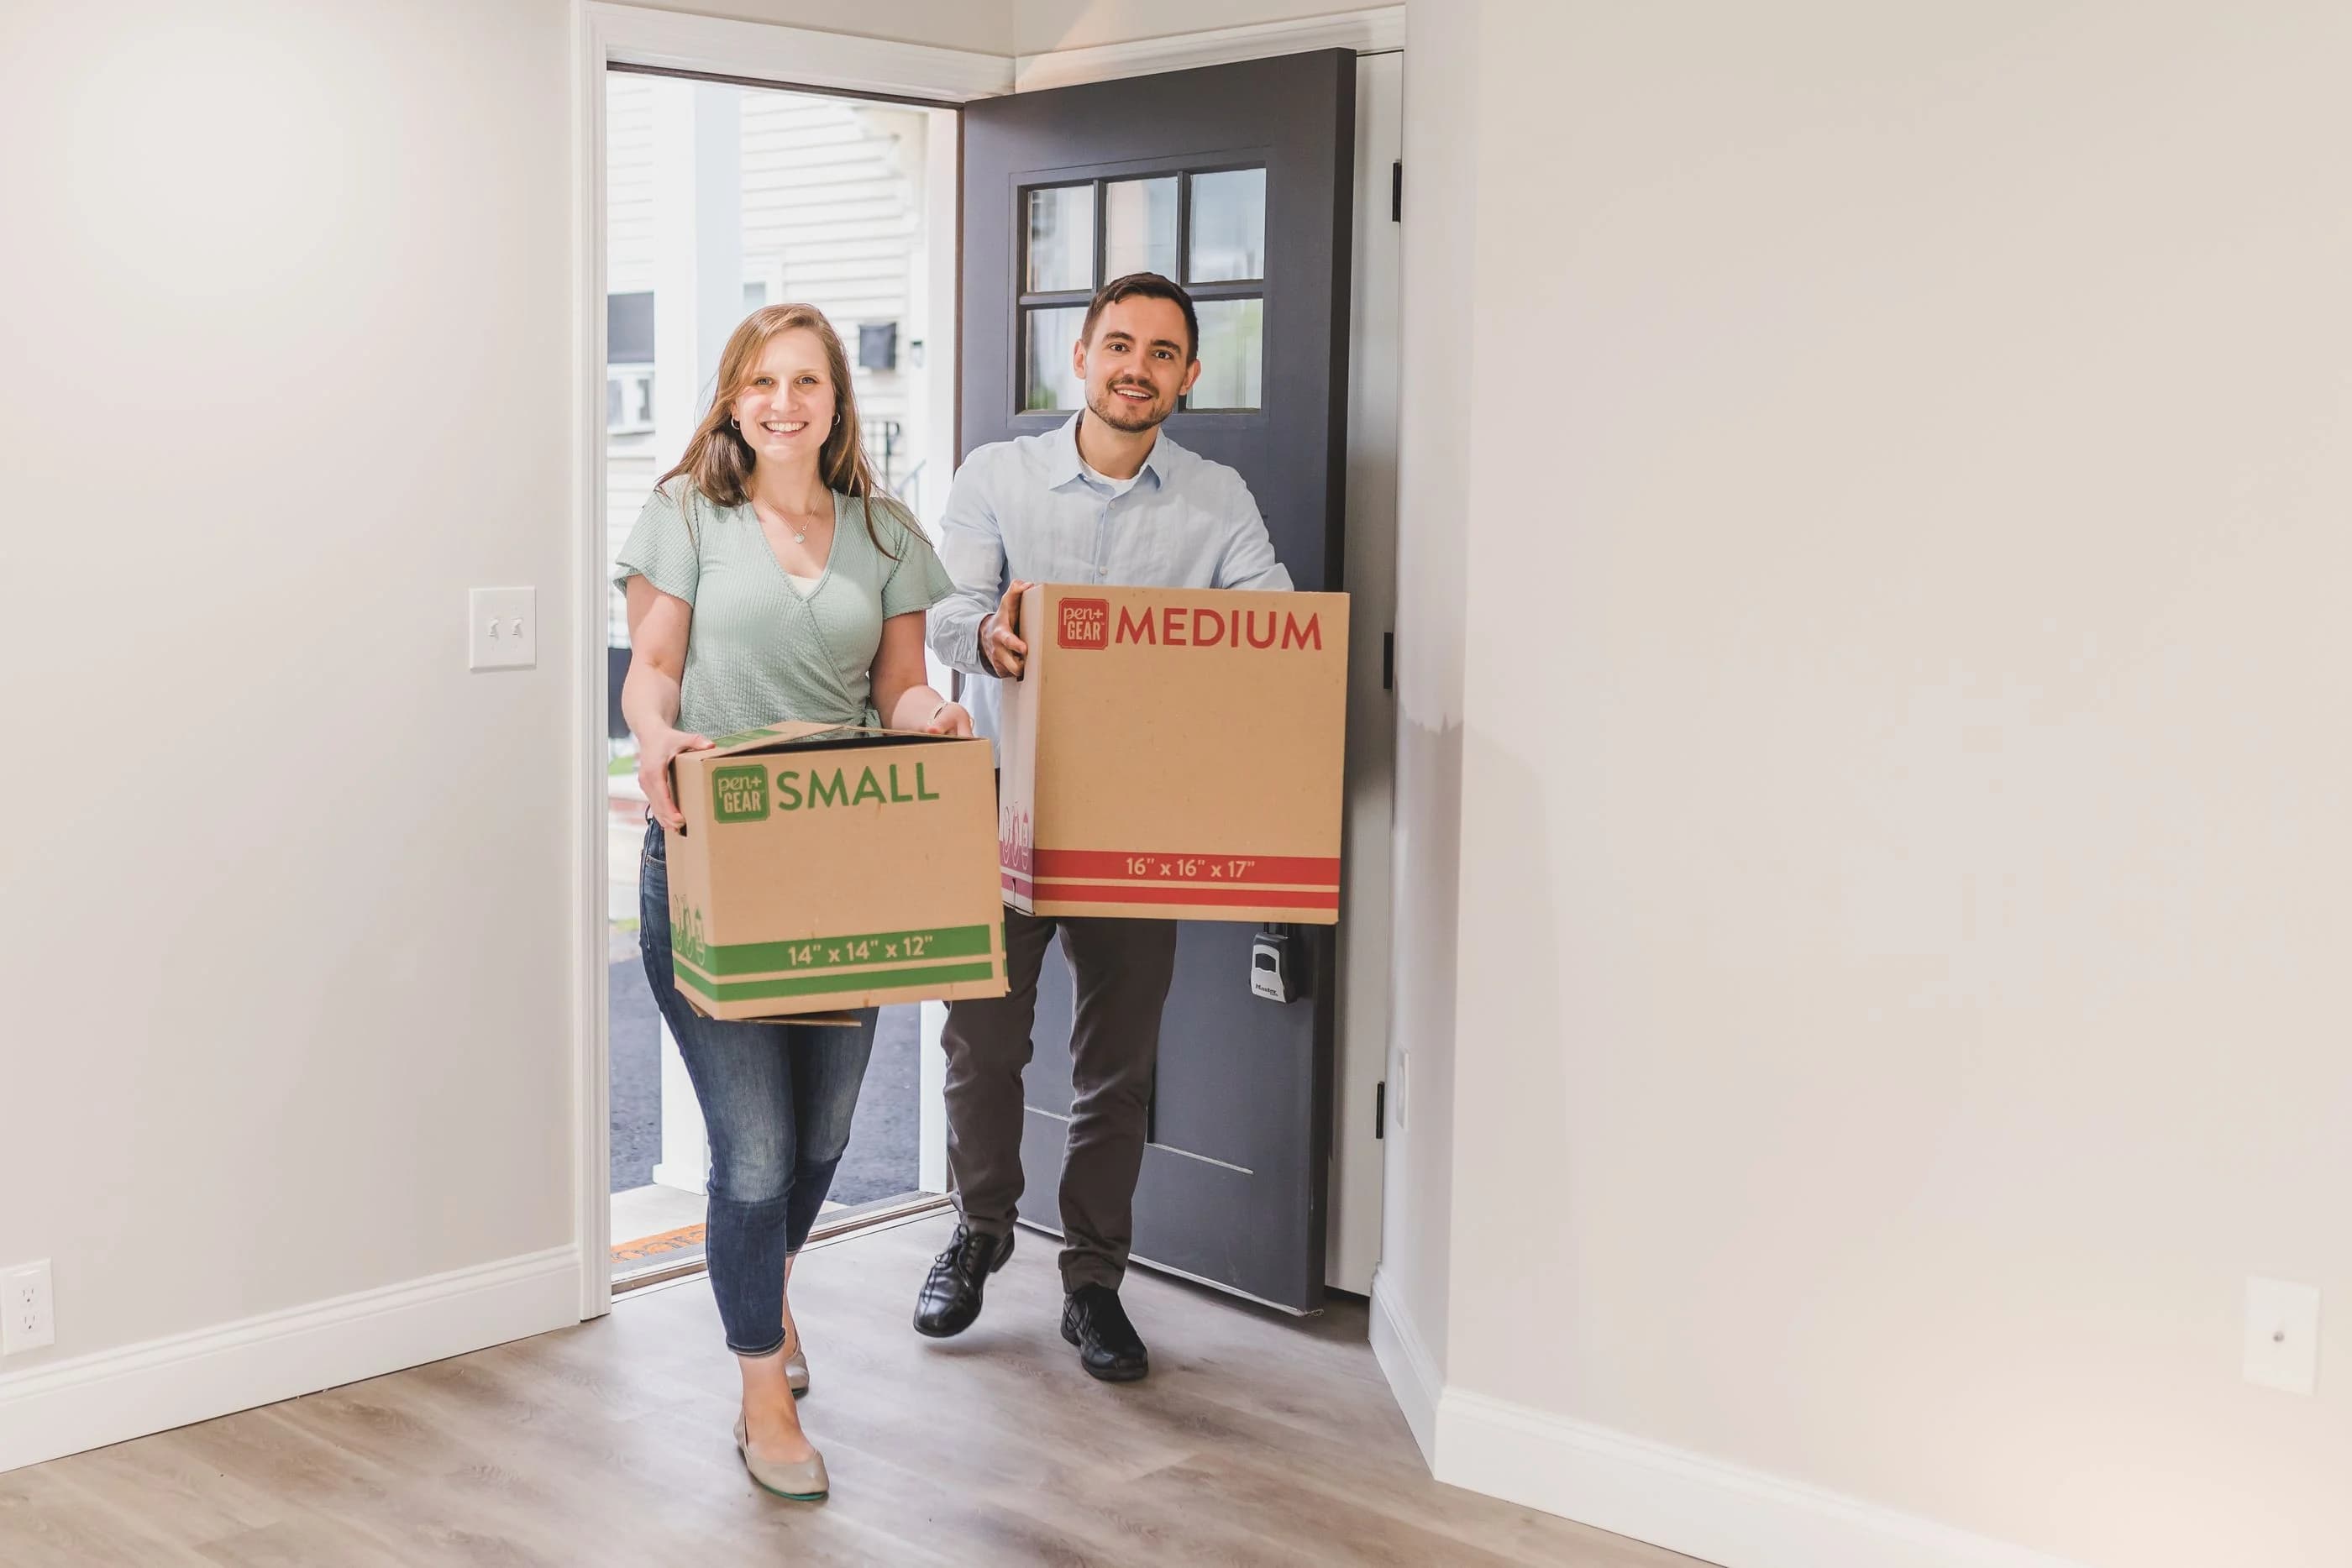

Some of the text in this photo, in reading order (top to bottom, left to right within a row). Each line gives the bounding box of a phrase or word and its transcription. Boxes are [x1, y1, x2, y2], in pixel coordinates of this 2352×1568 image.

[1063, 607, 1103, 626] pen+
[1067, 621, 1101, 641] GEAR
[1116, 606, 1322, 650] MEDIUM
[717, 776, 762, 799] pen+
[775, 762, 940, 811] SMALL
[723, 790, 762, 814] GEAR
[1159, 863, 1171, 876] x
[1210, 865, 1222, 878] x
[828, 948, 840, 962] x
[885, 943, 898, 958] x
